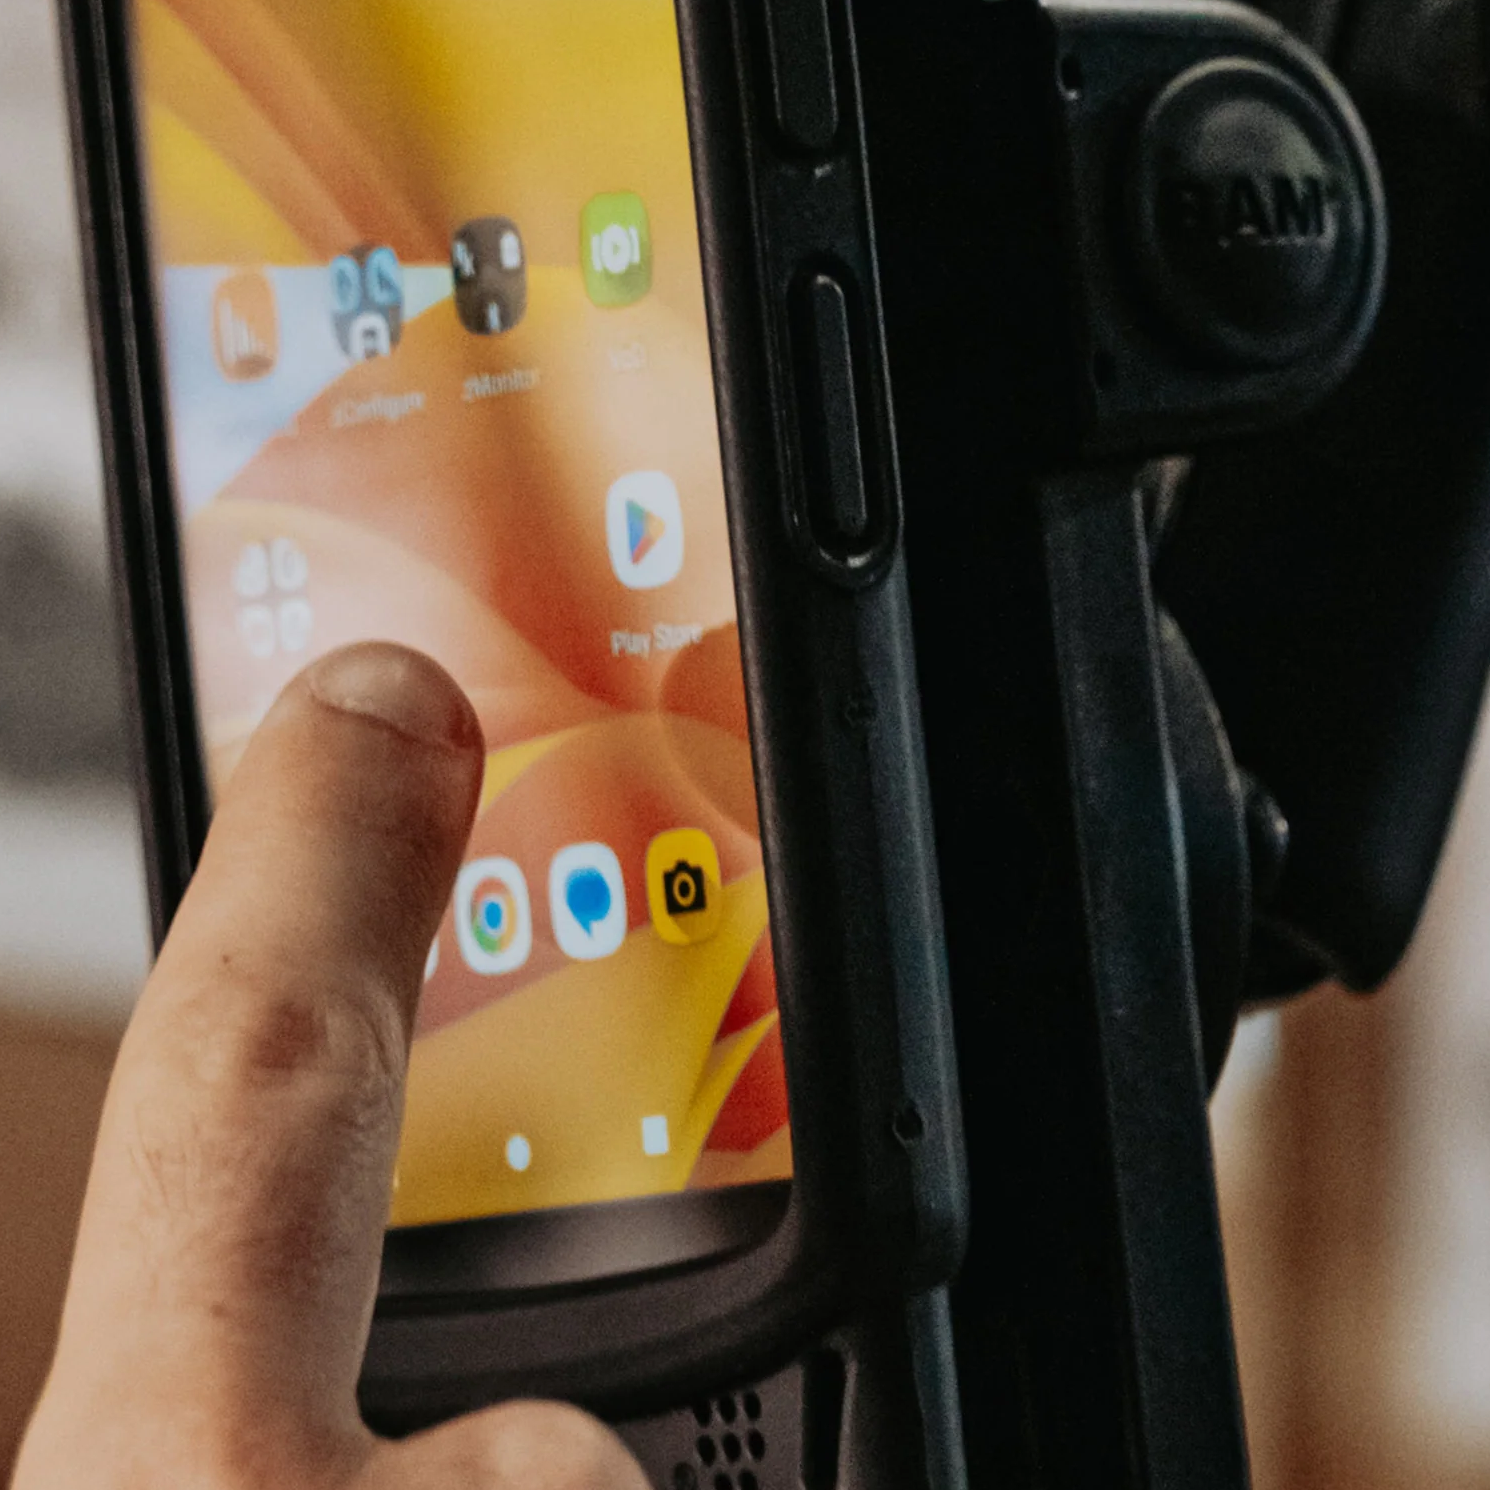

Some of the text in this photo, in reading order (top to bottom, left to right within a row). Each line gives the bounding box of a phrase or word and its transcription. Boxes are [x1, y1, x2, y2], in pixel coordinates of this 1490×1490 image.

[1159, 173, 1327, 245] RAM
[610, 622, 704, 660] Play Store
